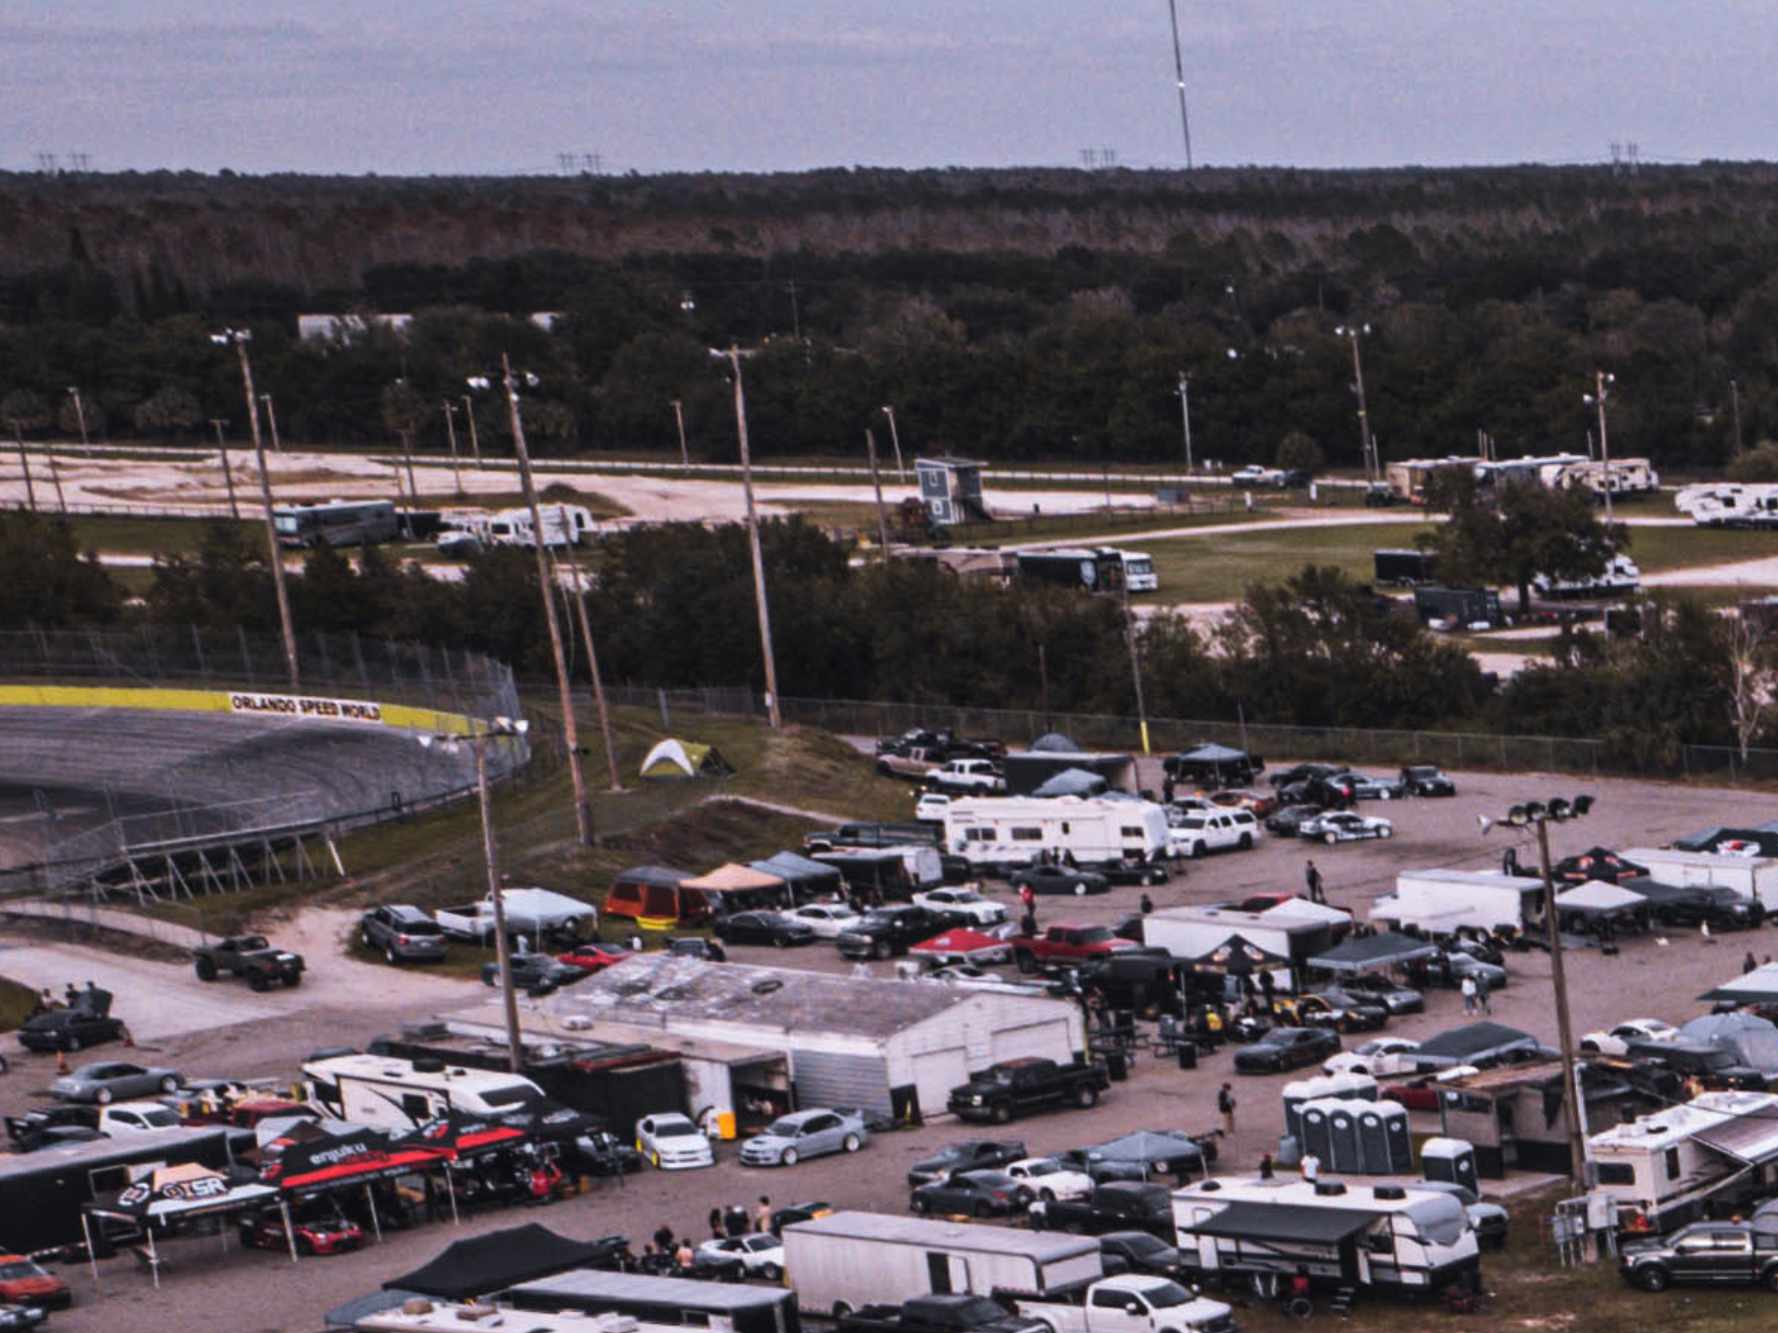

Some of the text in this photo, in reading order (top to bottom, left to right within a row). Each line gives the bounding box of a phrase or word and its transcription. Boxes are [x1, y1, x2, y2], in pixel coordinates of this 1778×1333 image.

[232, 695, 381, 720] ORLANDO SPEED WORLD
